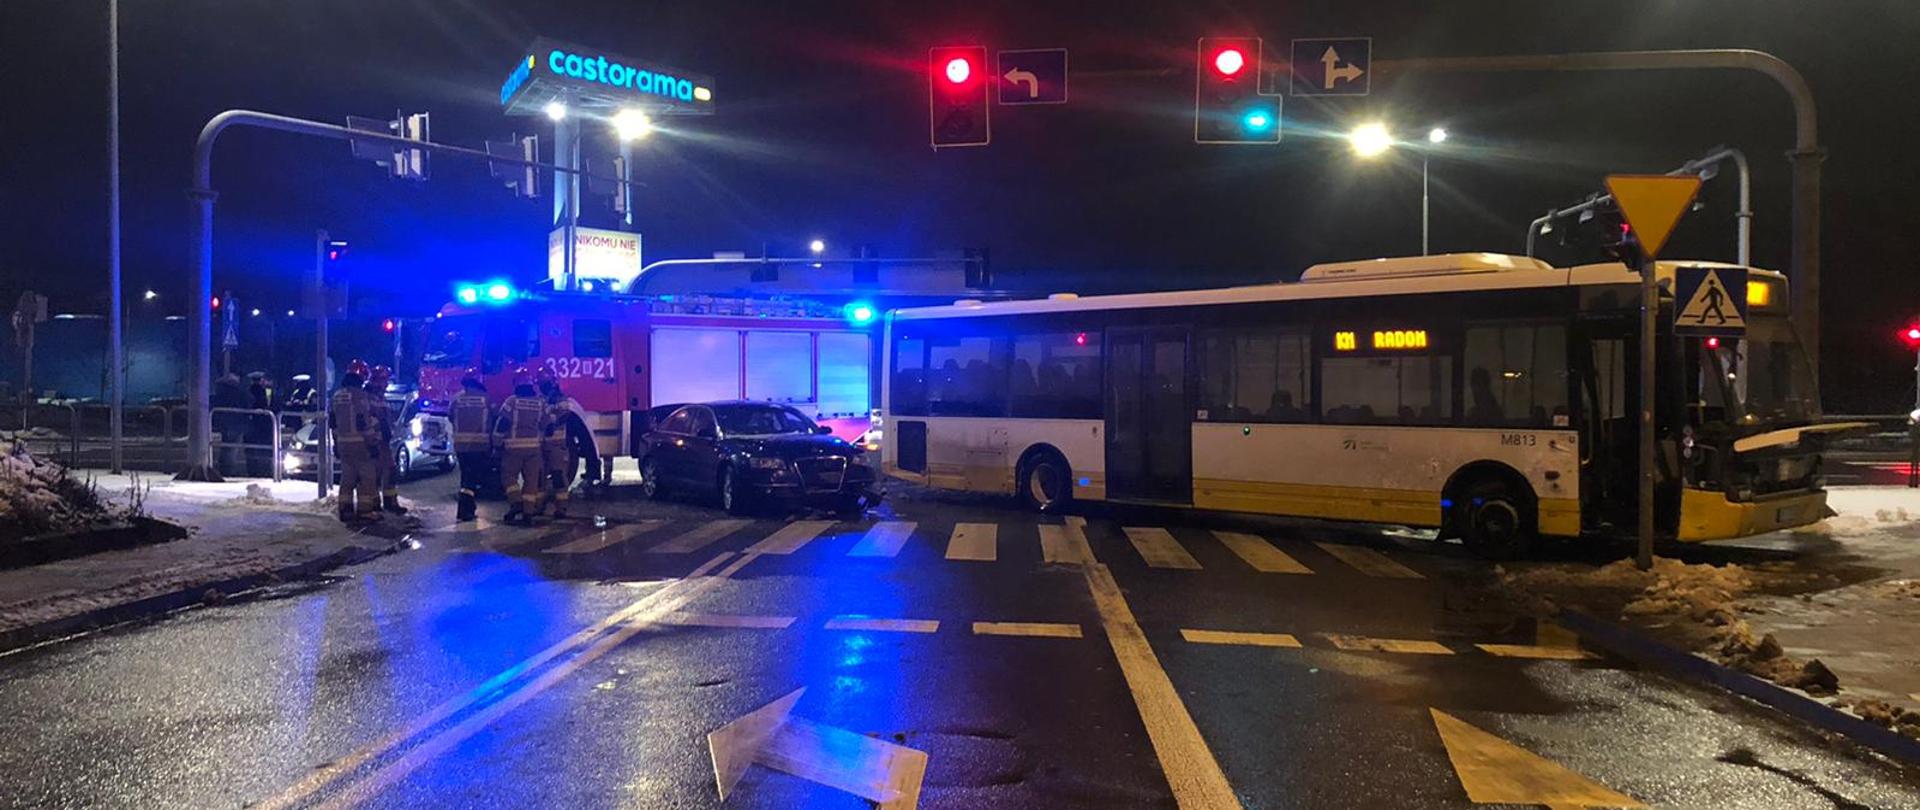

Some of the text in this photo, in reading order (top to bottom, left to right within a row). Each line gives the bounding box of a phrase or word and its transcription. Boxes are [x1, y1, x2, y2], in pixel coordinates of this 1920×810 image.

[549, 50, 693, 101] castorama
[576, 234, 637, 251] NIKOMU NIE
[1374, 330, 1427, 348] RADOM
[1501, 434, 1537, 447] M813
